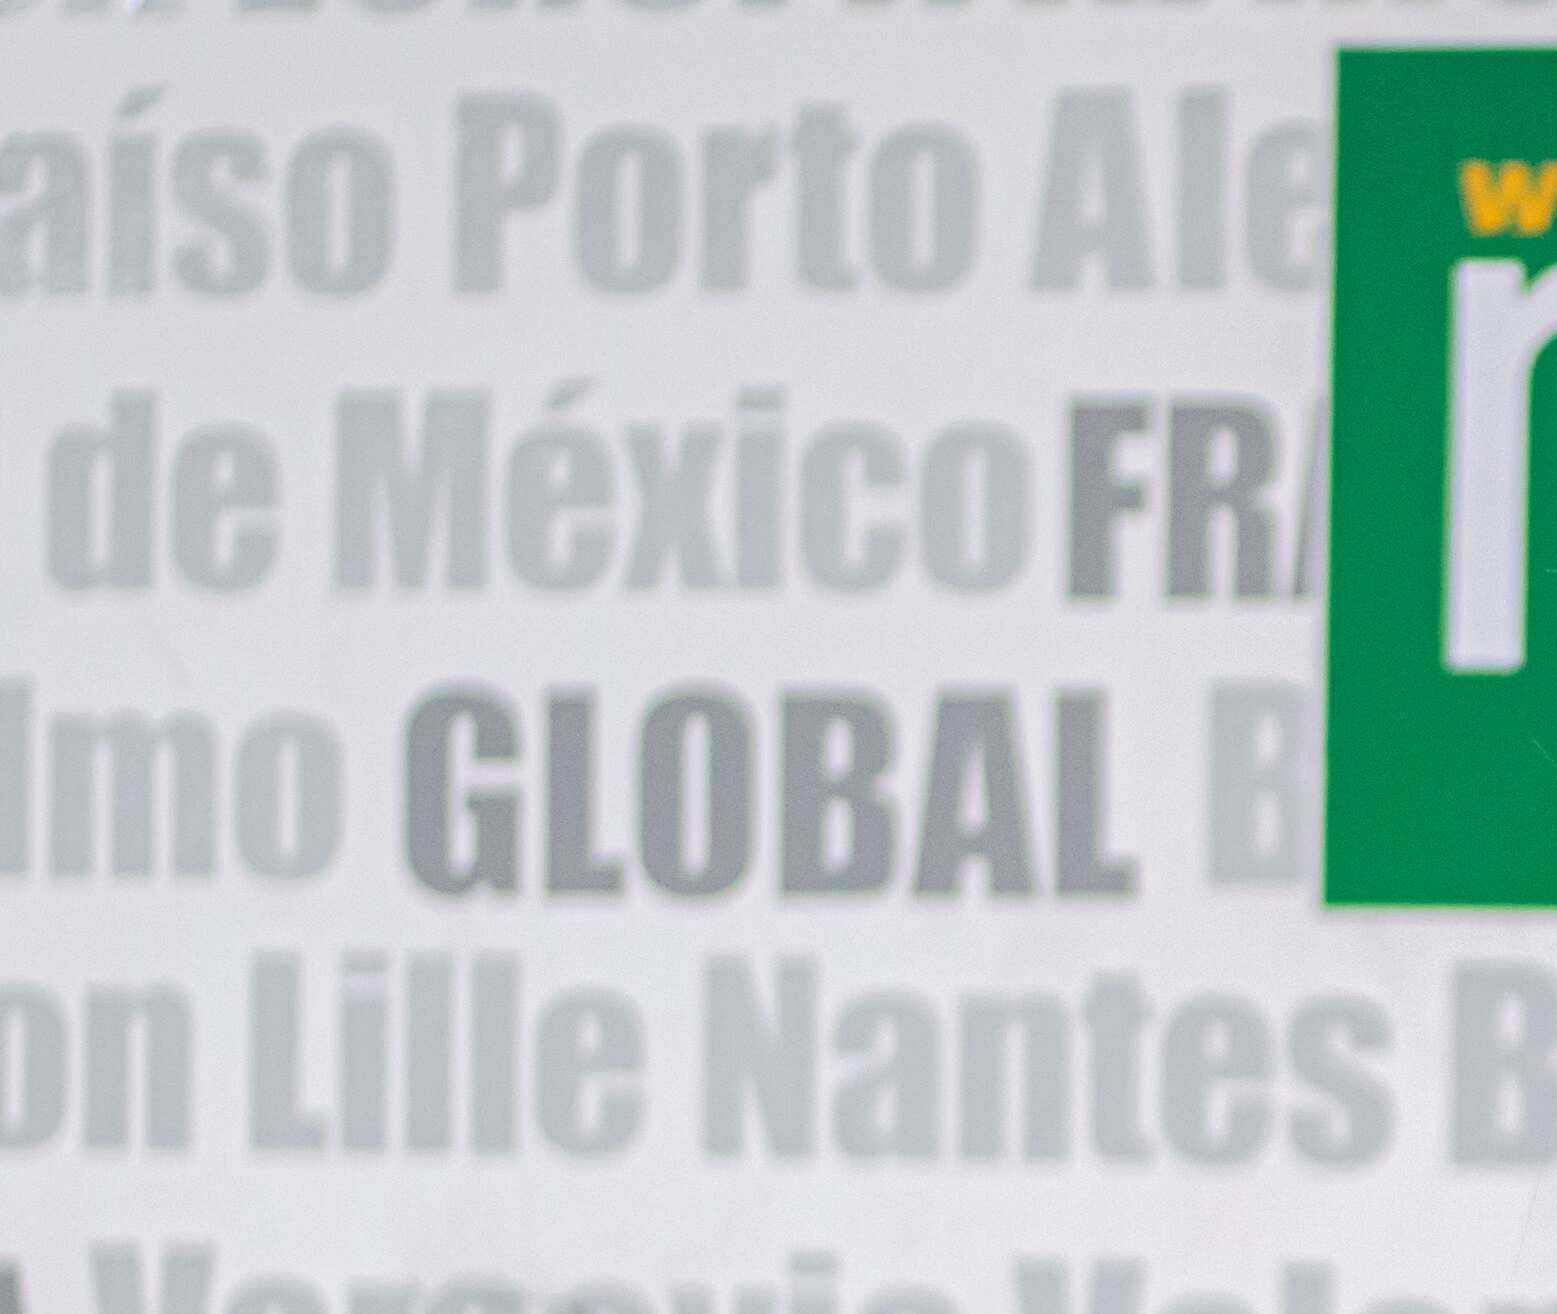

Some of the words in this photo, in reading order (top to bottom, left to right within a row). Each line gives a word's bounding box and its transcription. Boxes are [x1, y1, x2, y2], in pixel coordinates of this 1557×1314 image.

[450, 88, 982, 298] Porto
[1030, 84, 1333, 296] Ale
[42, 387, 280, 595] de
[330, 380, 1035, 597] México
[400, 680, 1140, 900] GLOBAL
[248, 948, 647, 1162] Lille
[700, 953, 1393, 1172] Nantes
